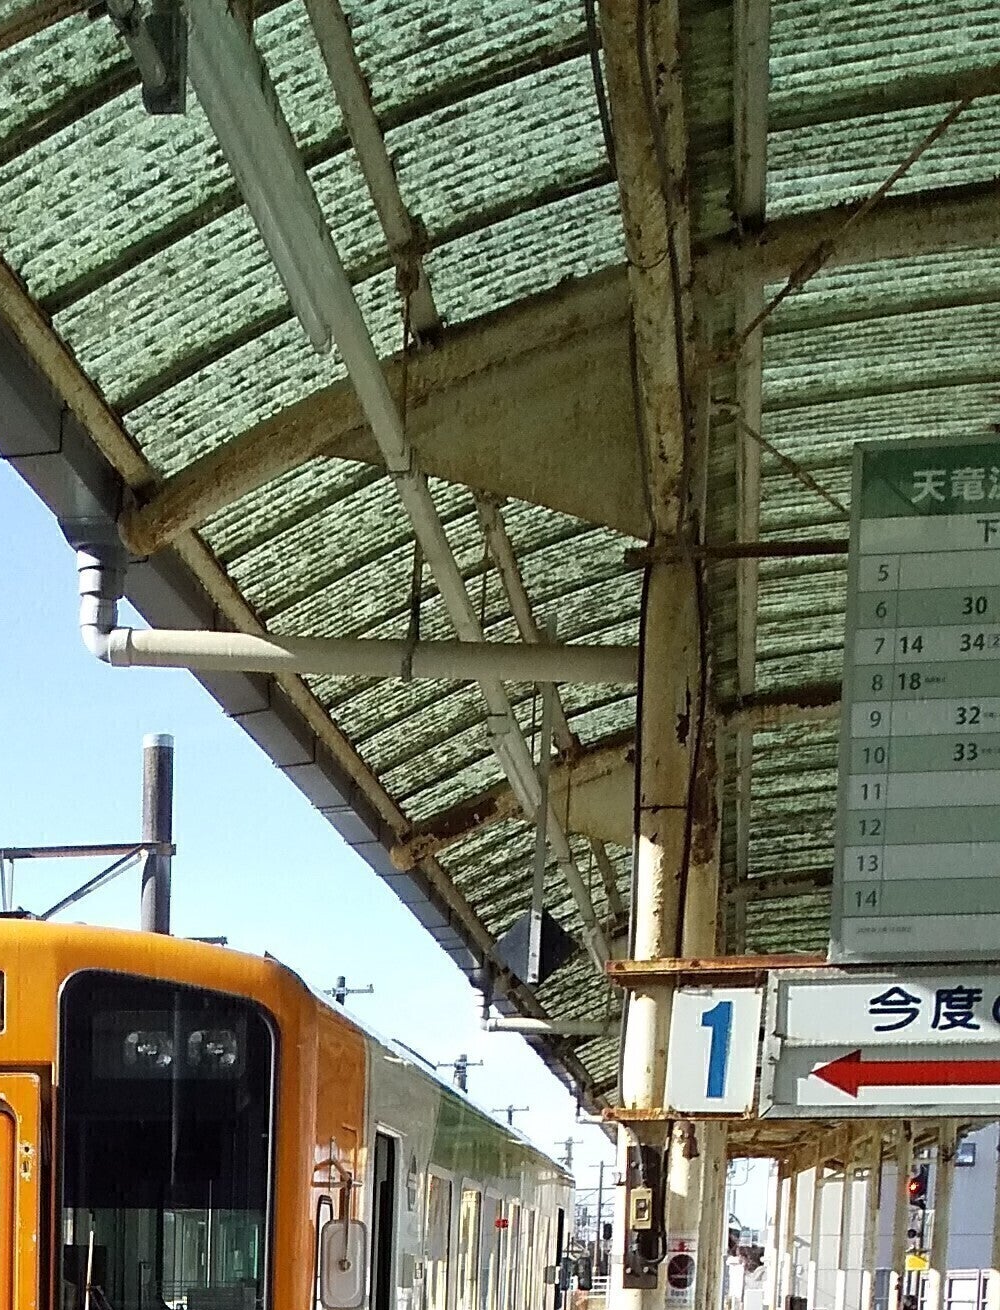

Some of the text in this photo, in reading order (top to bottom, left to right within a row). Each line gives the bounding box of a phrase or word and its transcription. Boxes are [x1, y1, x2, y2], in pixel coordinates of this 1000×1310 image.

[878, 564, 889, 582] 5
[875, 596, 988, 618] 6 30
[875, 637, 886, 655] 7
[899, 635, 923, 654] 14
[959, 633, 985, 652] 34
[871, 672, 921, 691] 8 18
[870, 710, 882, 728] 9
[955, 706, 980, 725] 32
[863, 743, 978, 764] 10 33
[861, 783, 881, 800] 11
[859, 818, 881, 836] 12
[857, 854, 879, 872] 13
[855, 890, 877, 908] 14
[701, 1000, 733, 1099] 1
